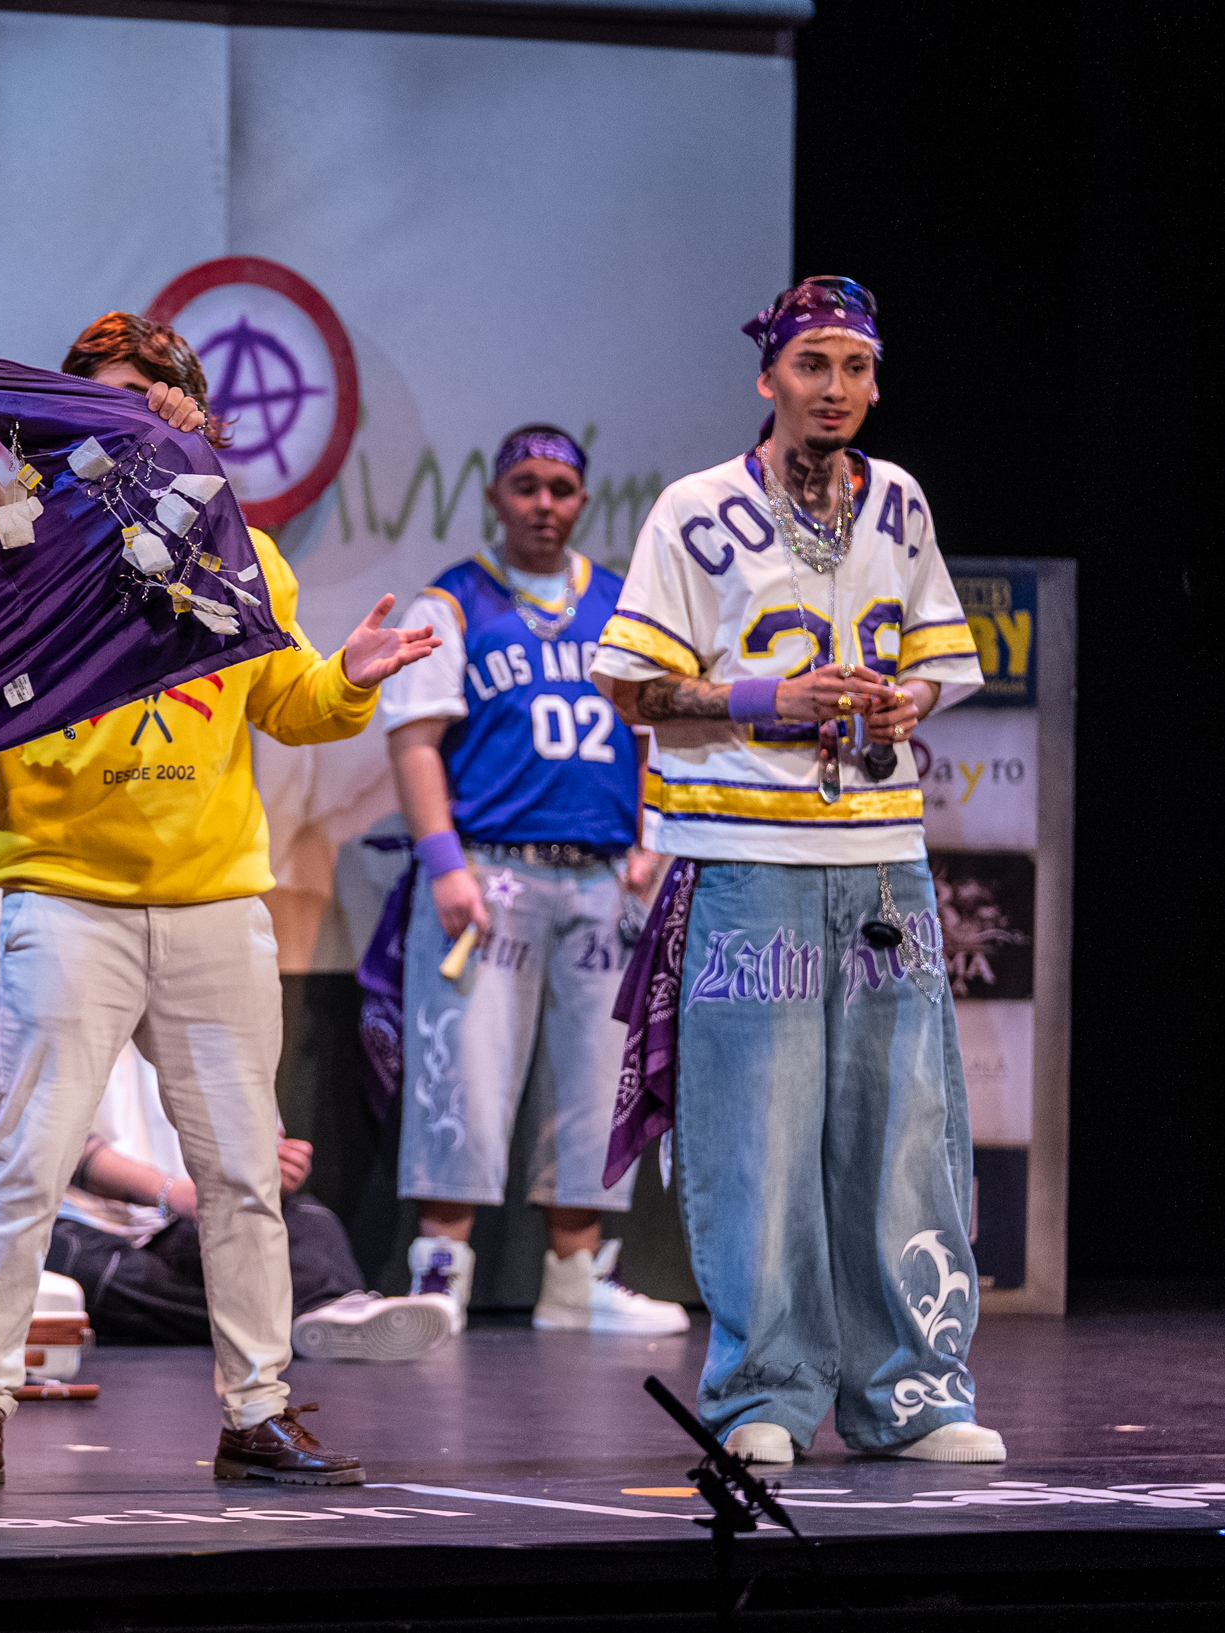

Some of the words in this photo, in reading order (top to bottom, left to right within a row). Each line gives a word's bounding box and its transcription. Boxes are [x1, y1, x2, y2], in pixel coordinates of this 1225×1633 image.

[681, 496, 774, 575] CO
[467, 643, 533, 701] LOS
[530, 693, 617, 764] 02
[103, 767, 151, 785] DESDE
[156, 764, 196, 780] 2002
